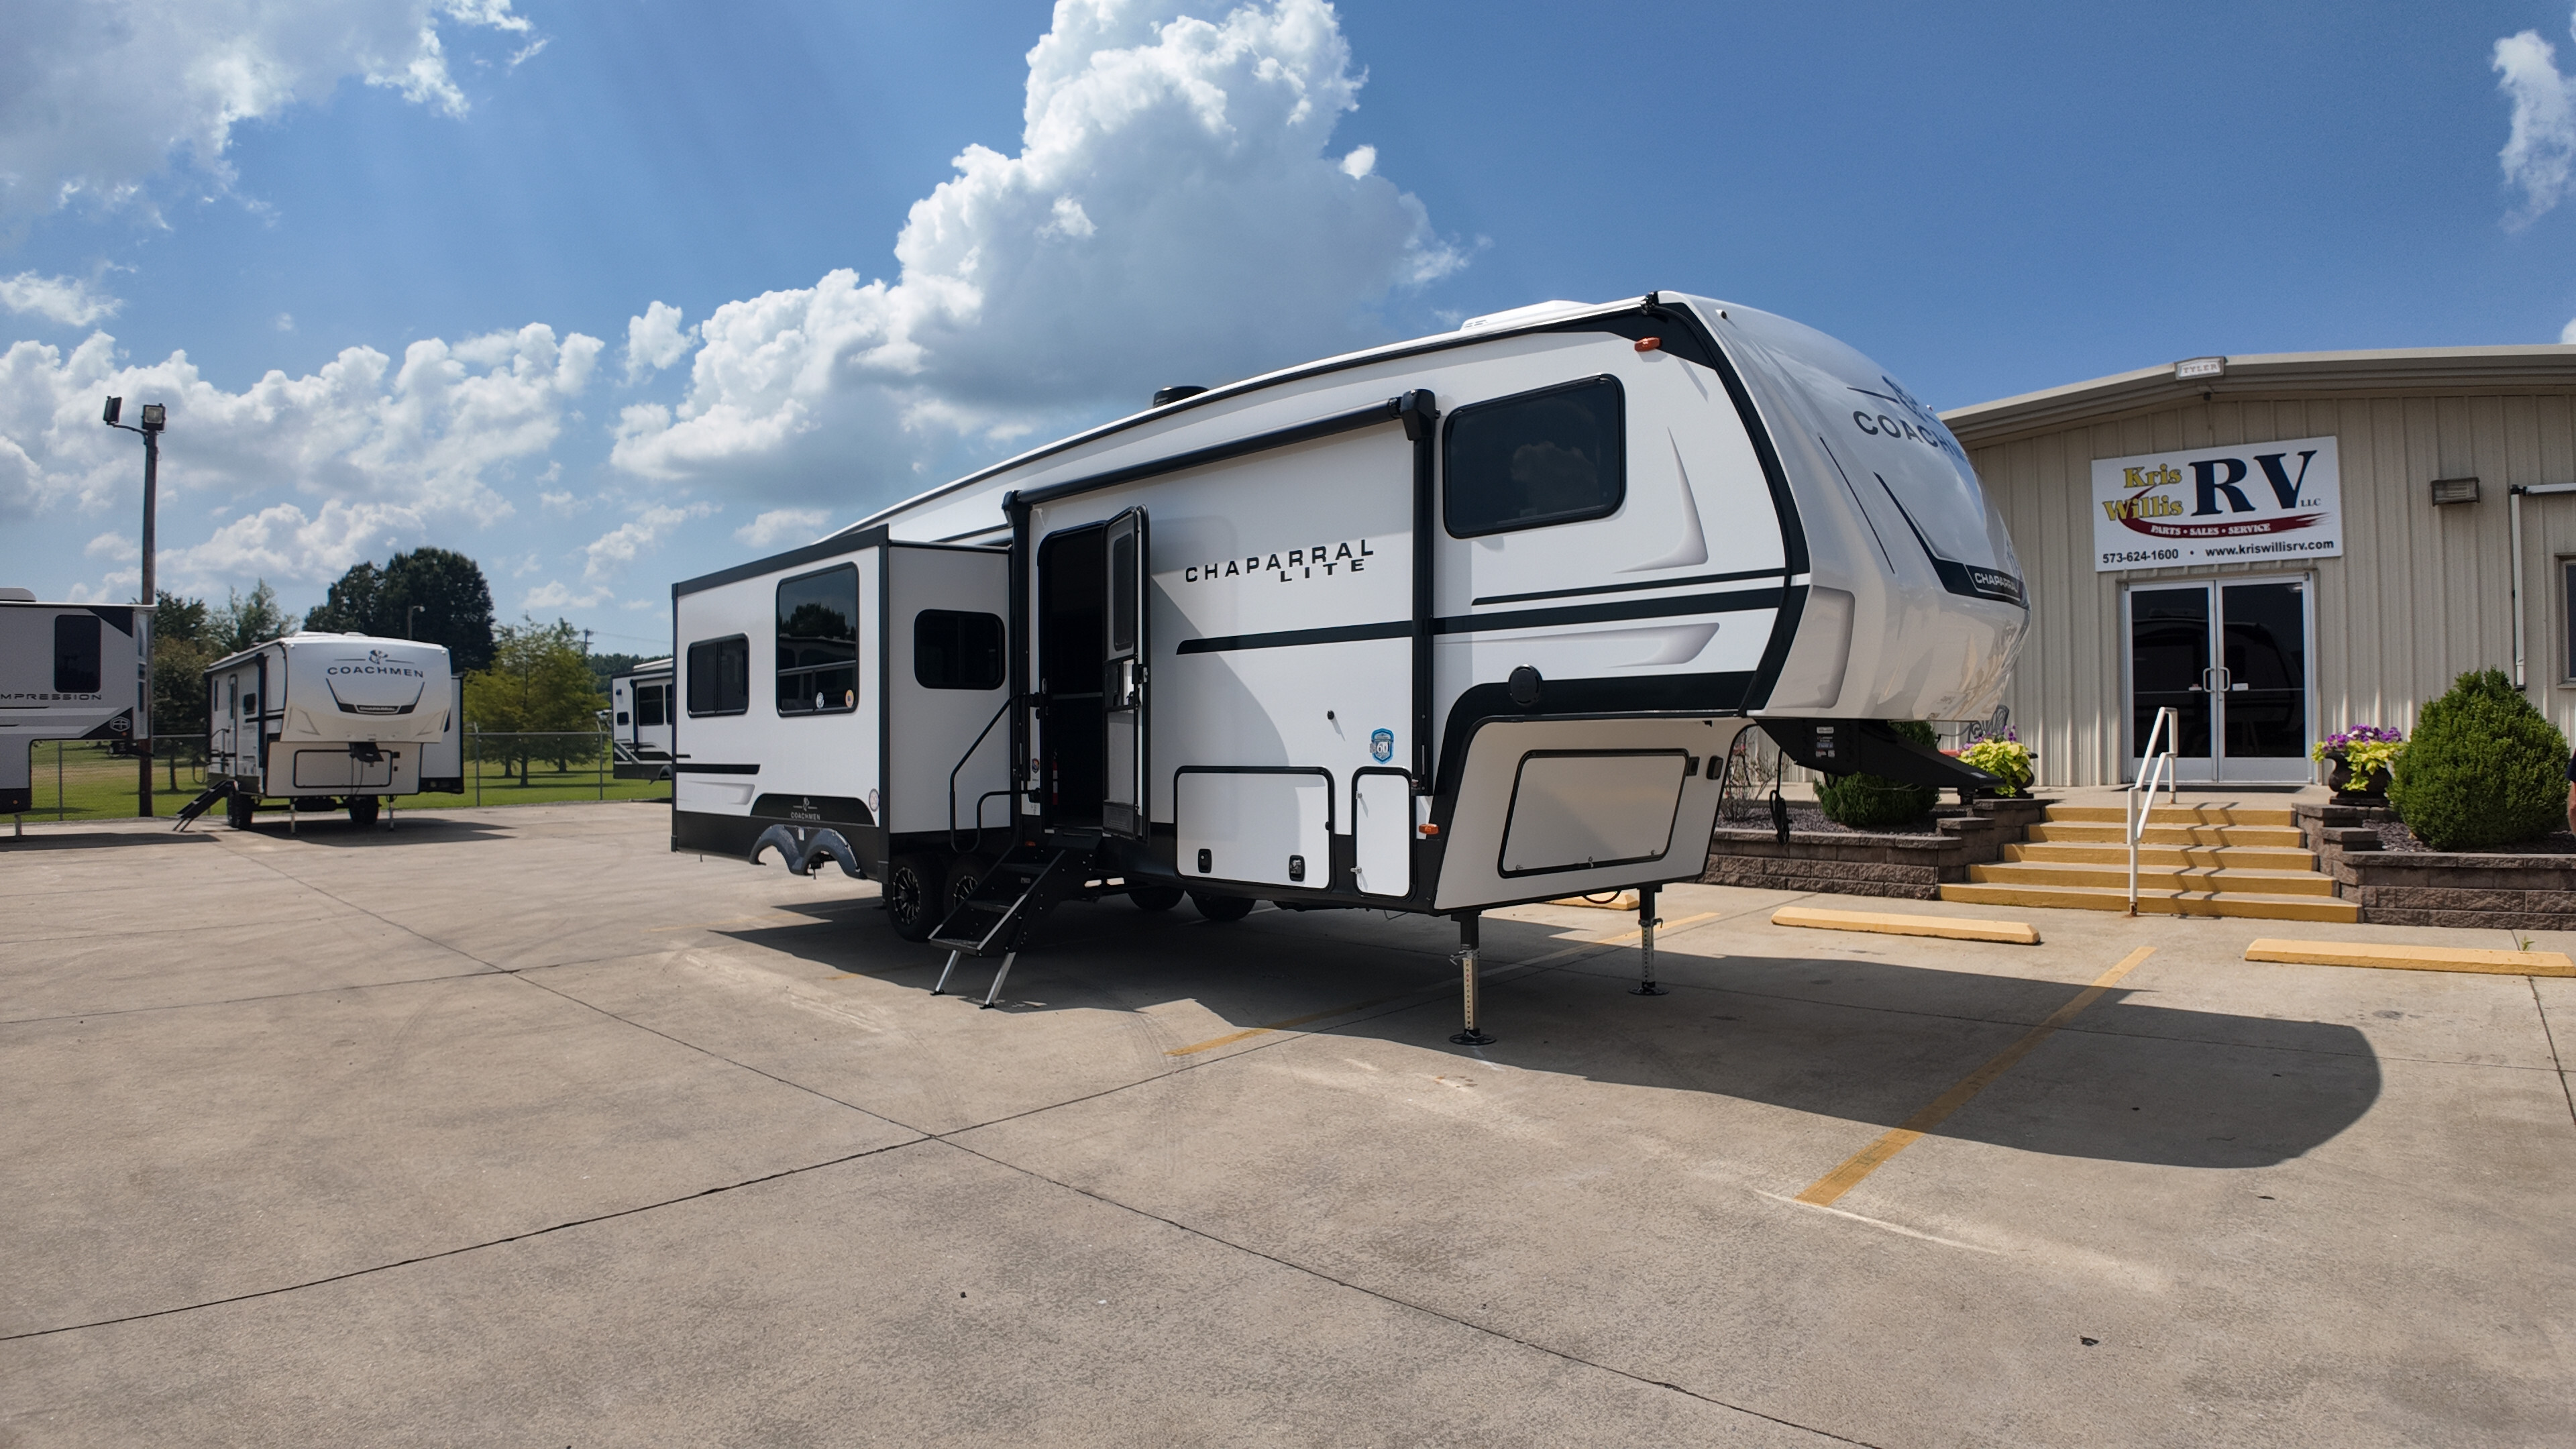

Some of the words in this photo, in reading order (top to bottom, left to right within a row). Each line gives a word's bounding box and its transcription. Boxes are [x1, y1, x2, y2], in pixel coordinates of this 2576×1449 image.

[2183, 364, 2216, 373] TYLER
[1853, 411, 1969, 466] COACH
[2123, 463, 2182, 488] Kris
[2188, 449, 2317, 517] RV
[2102, 495, 2184, 521] Willis
[2301, 498, 2321, 507] LLC
[2151, 525, 2181, 535] PARTS
[2190, 527, 2219, 536] SALES
[2228, 523, 2271, 534] SERVICE
[1185, 539, 1374, 582] CHAPARRAL
[2102, 549, 2179, 564] 573-624-1600
[2205, 540, 2334, 557] www.kriswillisrv.com
[1280, 559, 1364, 582] LITE
[327, 666, 423, 678] COACHMEN
[790, 812, 820, 820] COACHMEN
